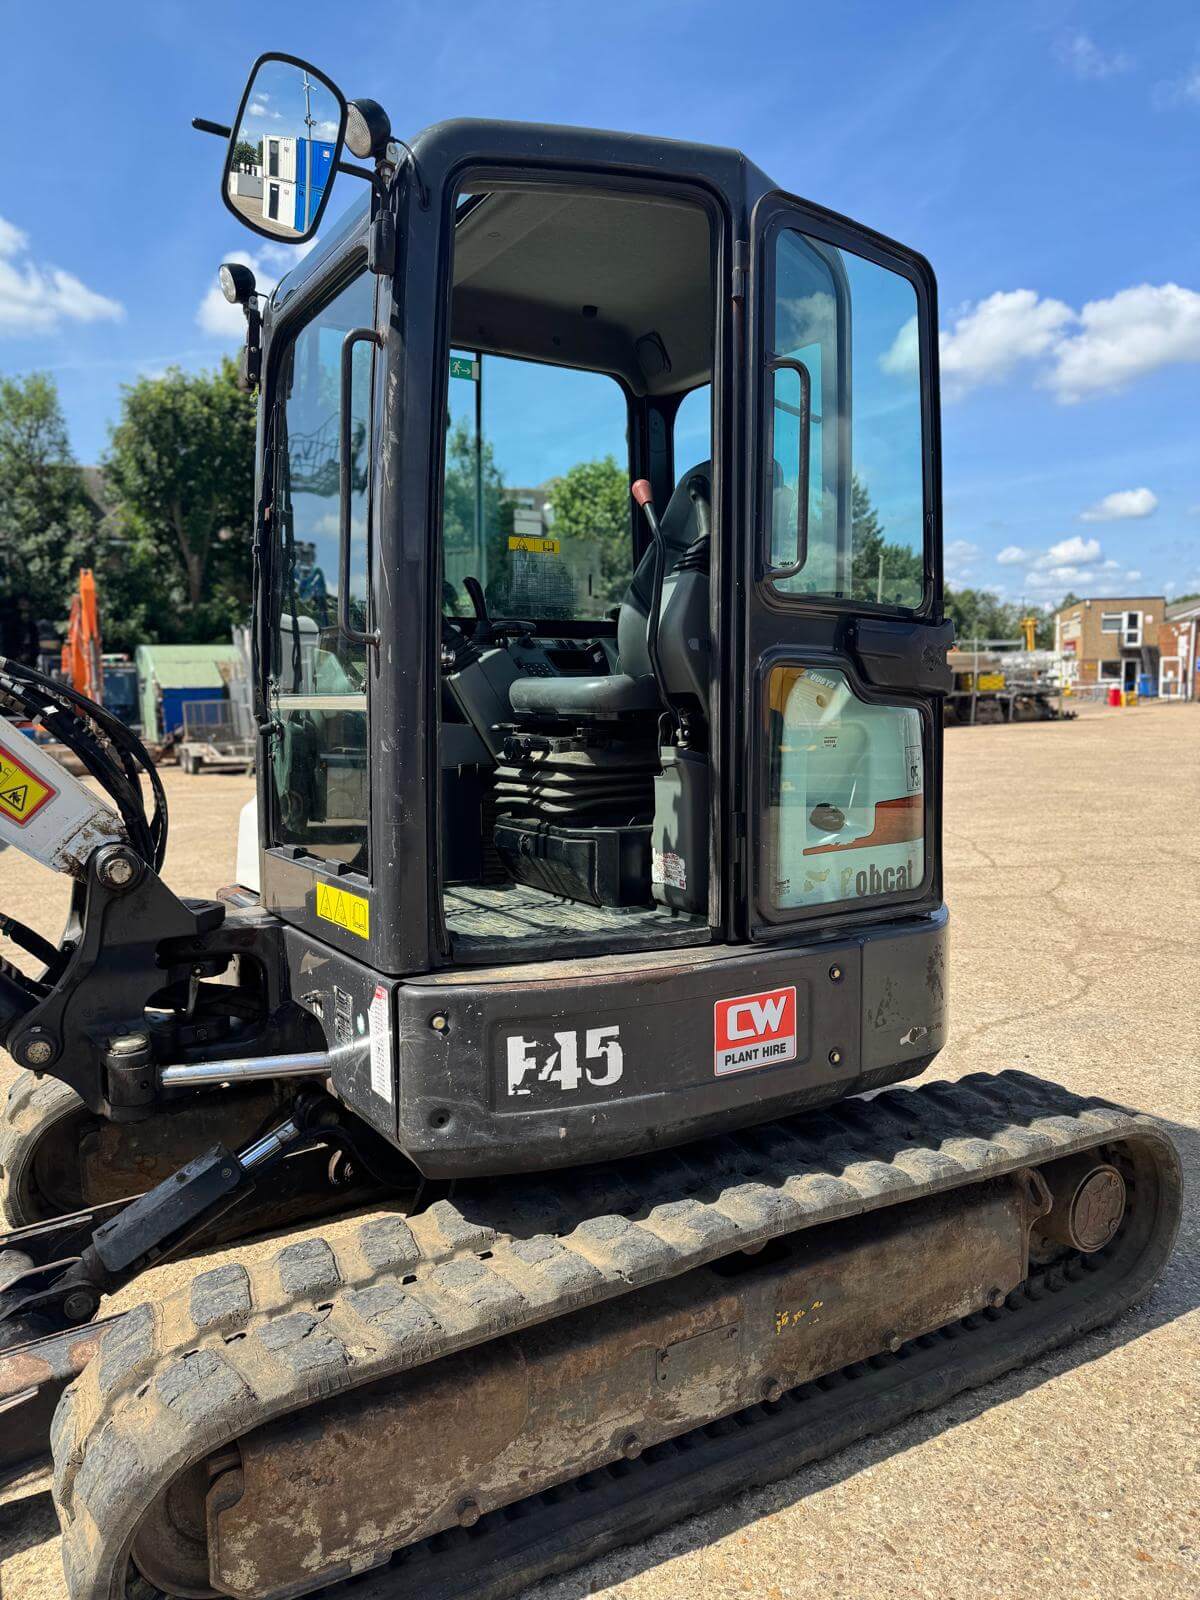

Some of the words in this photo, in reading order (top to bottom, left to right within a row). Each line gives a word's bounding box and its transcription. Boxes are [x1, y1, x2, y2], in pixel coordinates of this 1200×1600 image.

[727, 996, 787, 1041] CW
[507, 1026, 623, 1095] E45
[725, 1048, 759, 1066] PLANT
[762, 1043, 786, 1057] HIRE
